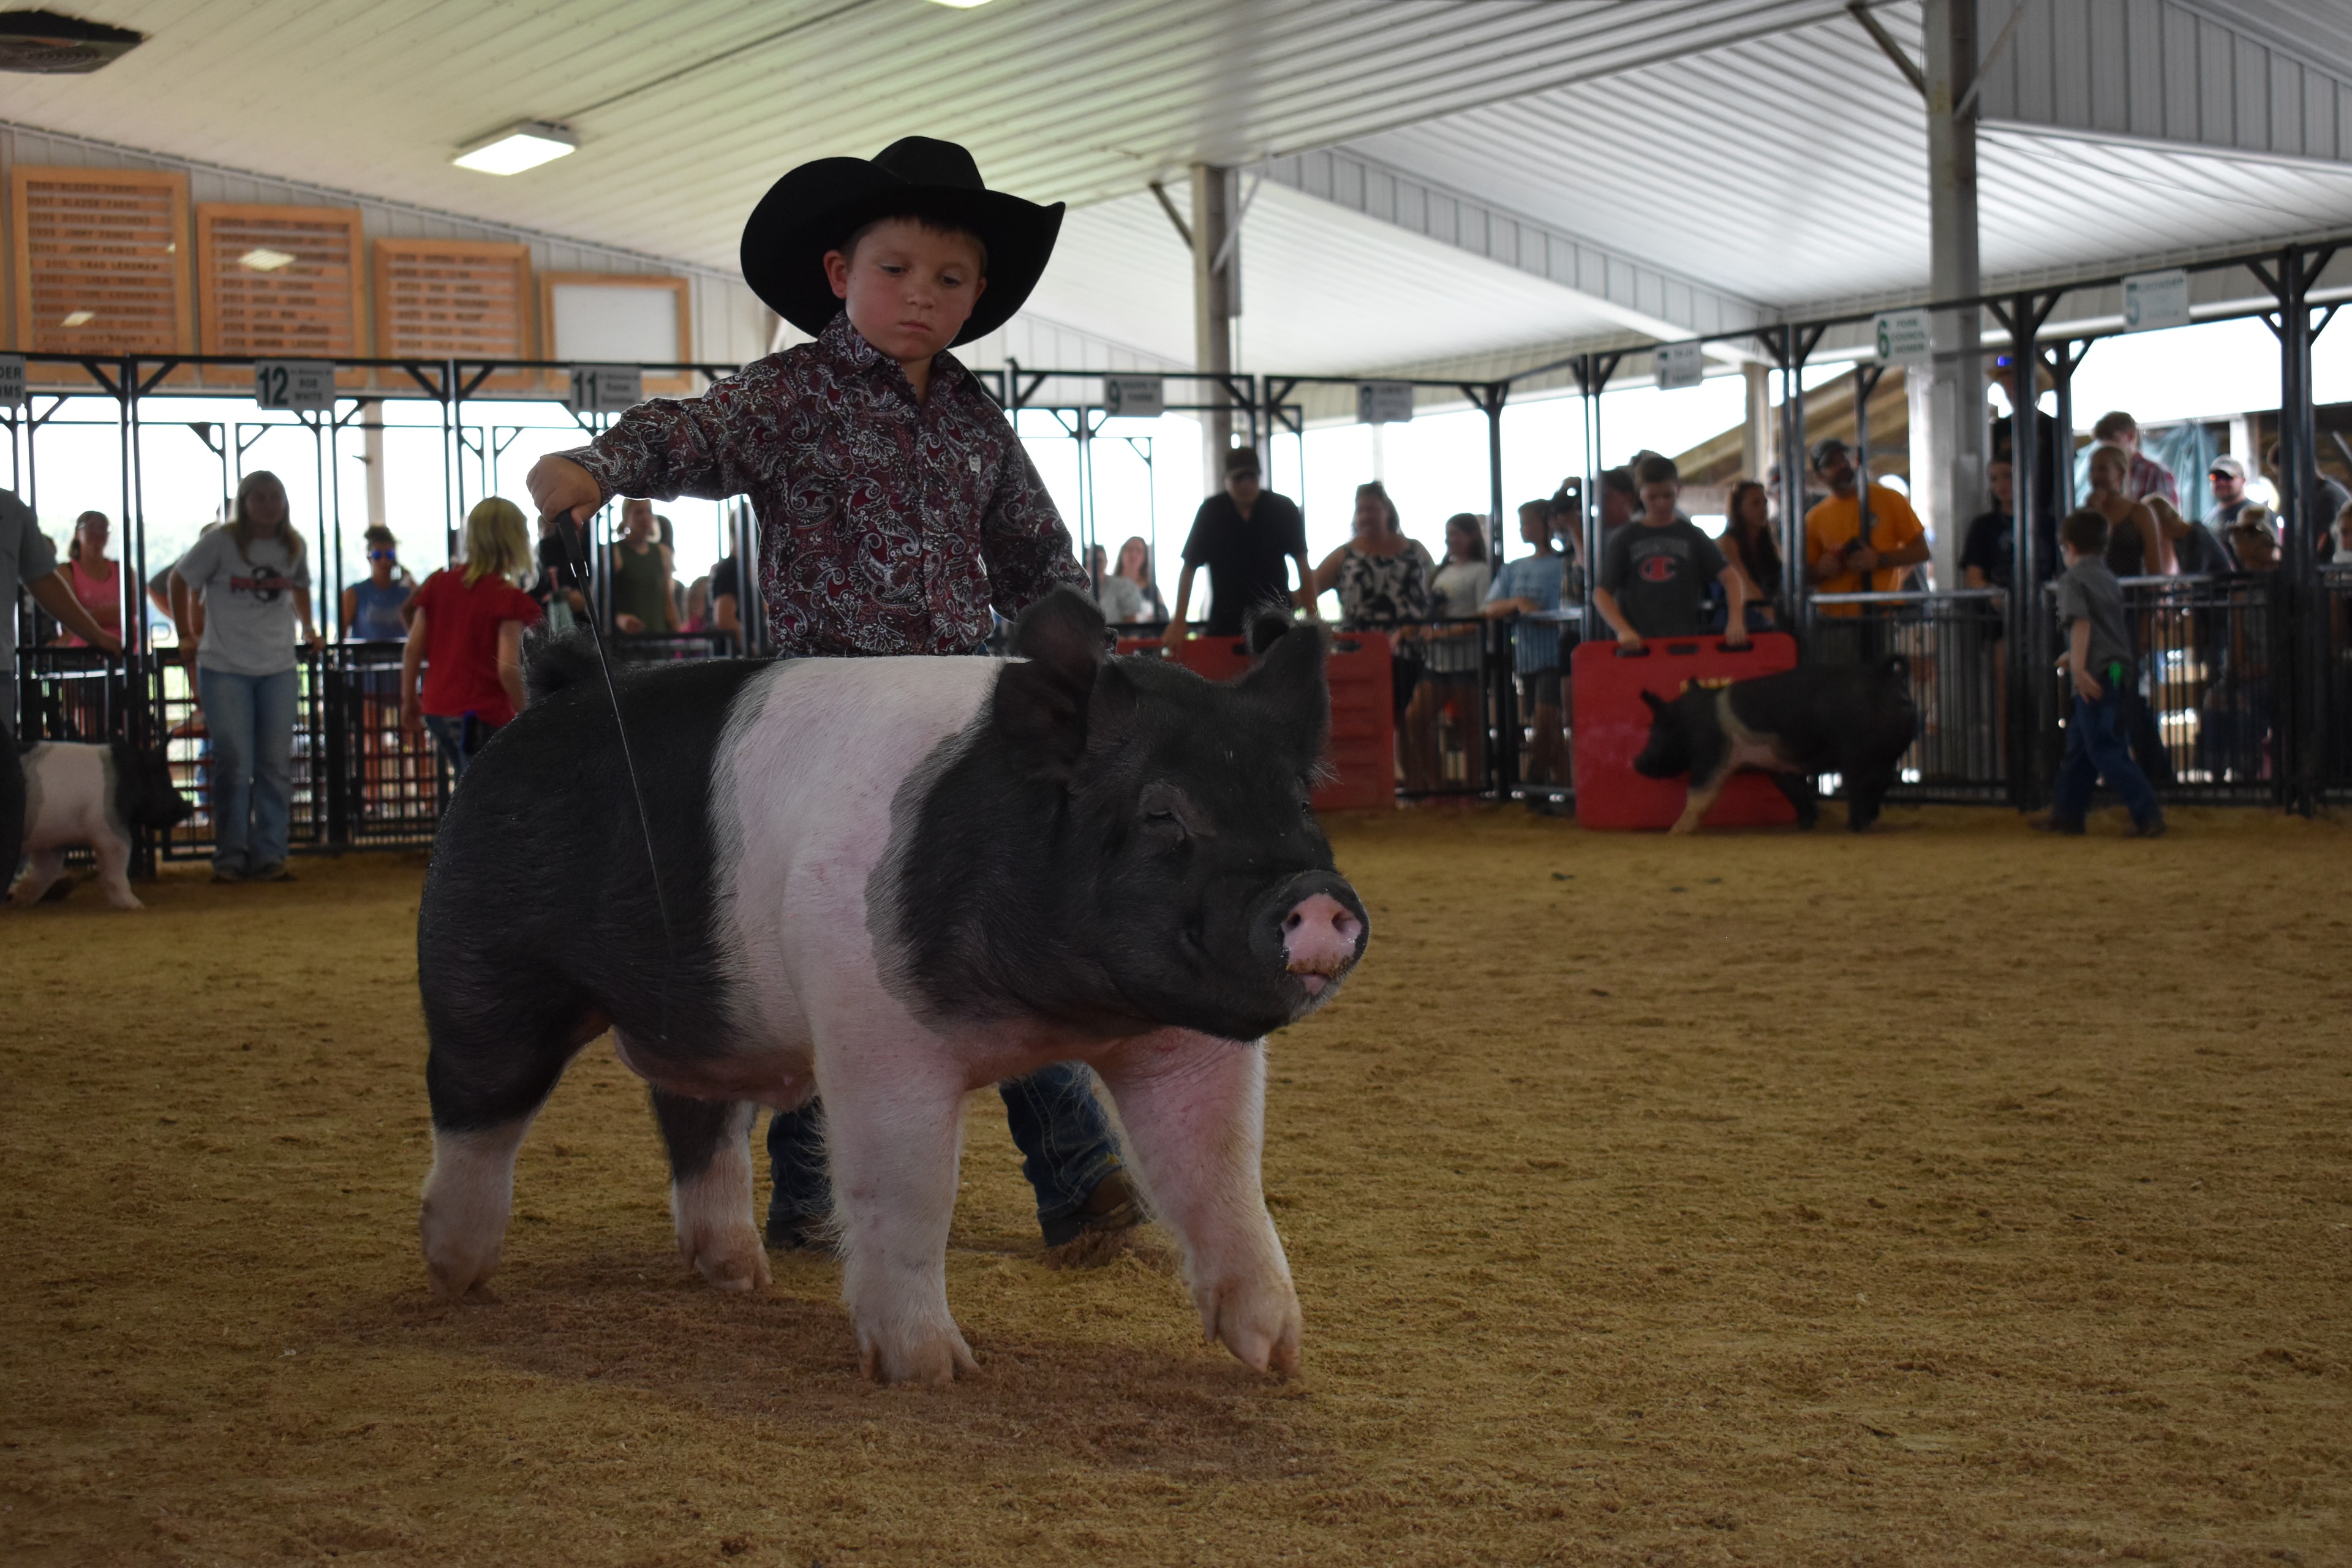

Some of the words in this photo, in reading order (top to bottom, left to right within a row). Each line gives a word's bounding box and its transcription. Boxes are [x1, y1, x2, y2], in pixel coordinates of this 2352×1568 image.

[2126, 283, 2140, 326] 5
[1877, 319, 1890, 360] 6
[1891, 330, 1926, 341] COUNCIL
[258, 366, 288, 405] 12
[573, 371, 597, 408] 11
[1109, 379, 1121, 415] 9
